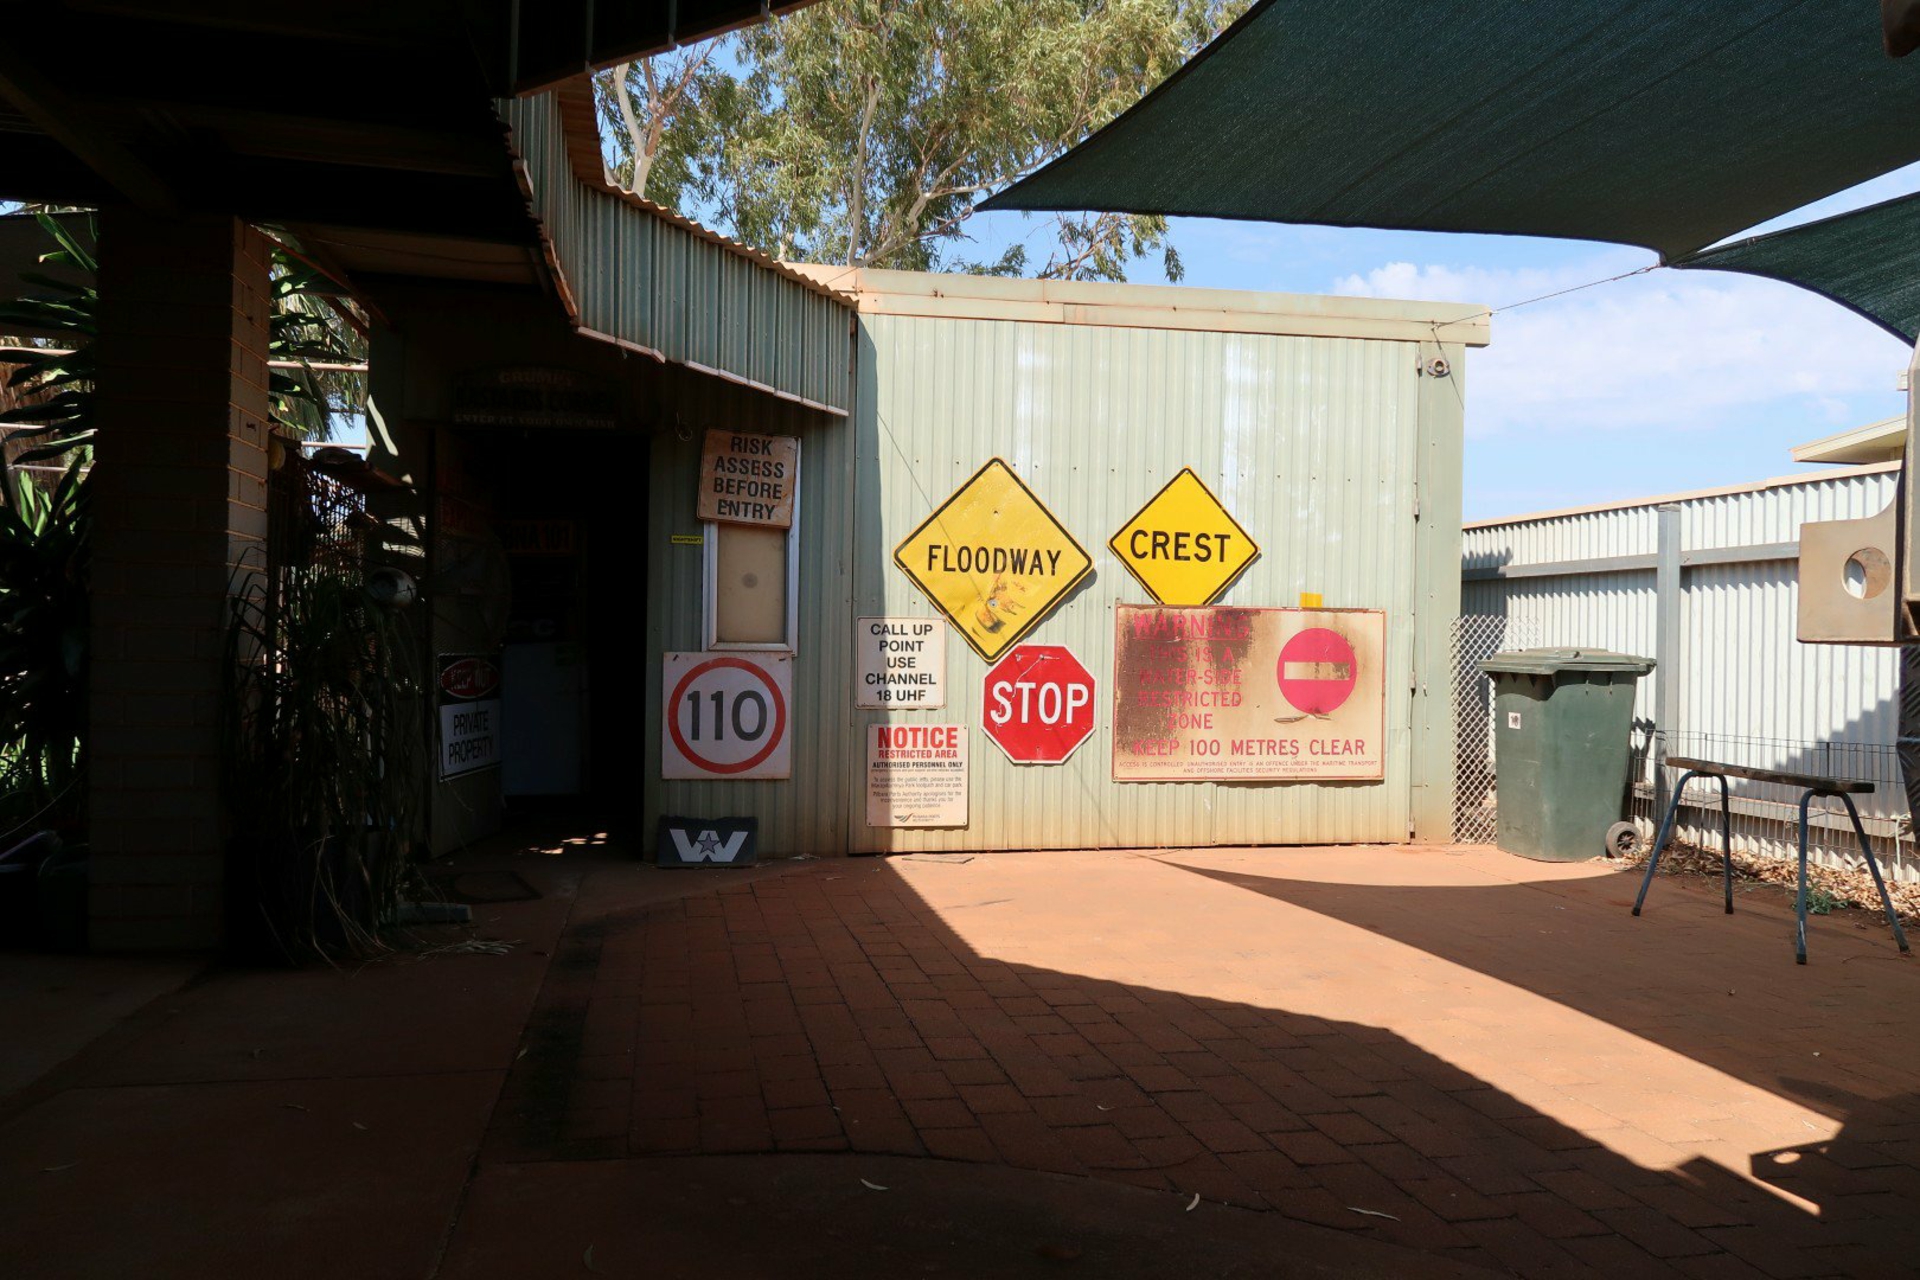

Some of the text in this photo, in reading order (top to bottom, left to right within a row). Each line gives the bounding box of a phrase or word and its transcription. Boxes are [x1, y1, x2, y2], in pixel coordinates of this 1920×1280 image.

[730, 435, 773, 456] RISK
[713, 456, 785, 479] ASSESS
[713, 477, 783, 500] BEFORE
[717, 499, 776, 520] ENTRY
[1130, 529, 1231, 562] CREST
[927, 544, 1062, 576] FLOODWAY
[870, 623, 933, 636] CALL UP
[1133, 613, 1250, 638] WARNING
[879, 640, 924, 652] POINT
[1149, 644, 1234, 663] THIS IS A
[887, 656, 916, 669] USE
[865, 672, 937, 685] CHANNEL
[1139, 667, 1242, 686] WATER-SIDE
[876, 689, 926, 701] 18 UHF
[990, 680, 1089, 725] STOP
[1138, 690, 1242, 707] RESTRICTED
[453, 710, 488, 737] PRIVATE
[686, 689, 768, 742] 110
[1167, 713, 1213, 731] ZONE
[877, 726, 958, 749] NOTICE
[1133, 738, 1366, 756] KEEP 100 METRES CLEAR
[448, 735, 493, 765] PROPERTY
[878, 749, 958, 759] RESTRICTED AREA
[872, 761, 911, 769] AUTHORISED
